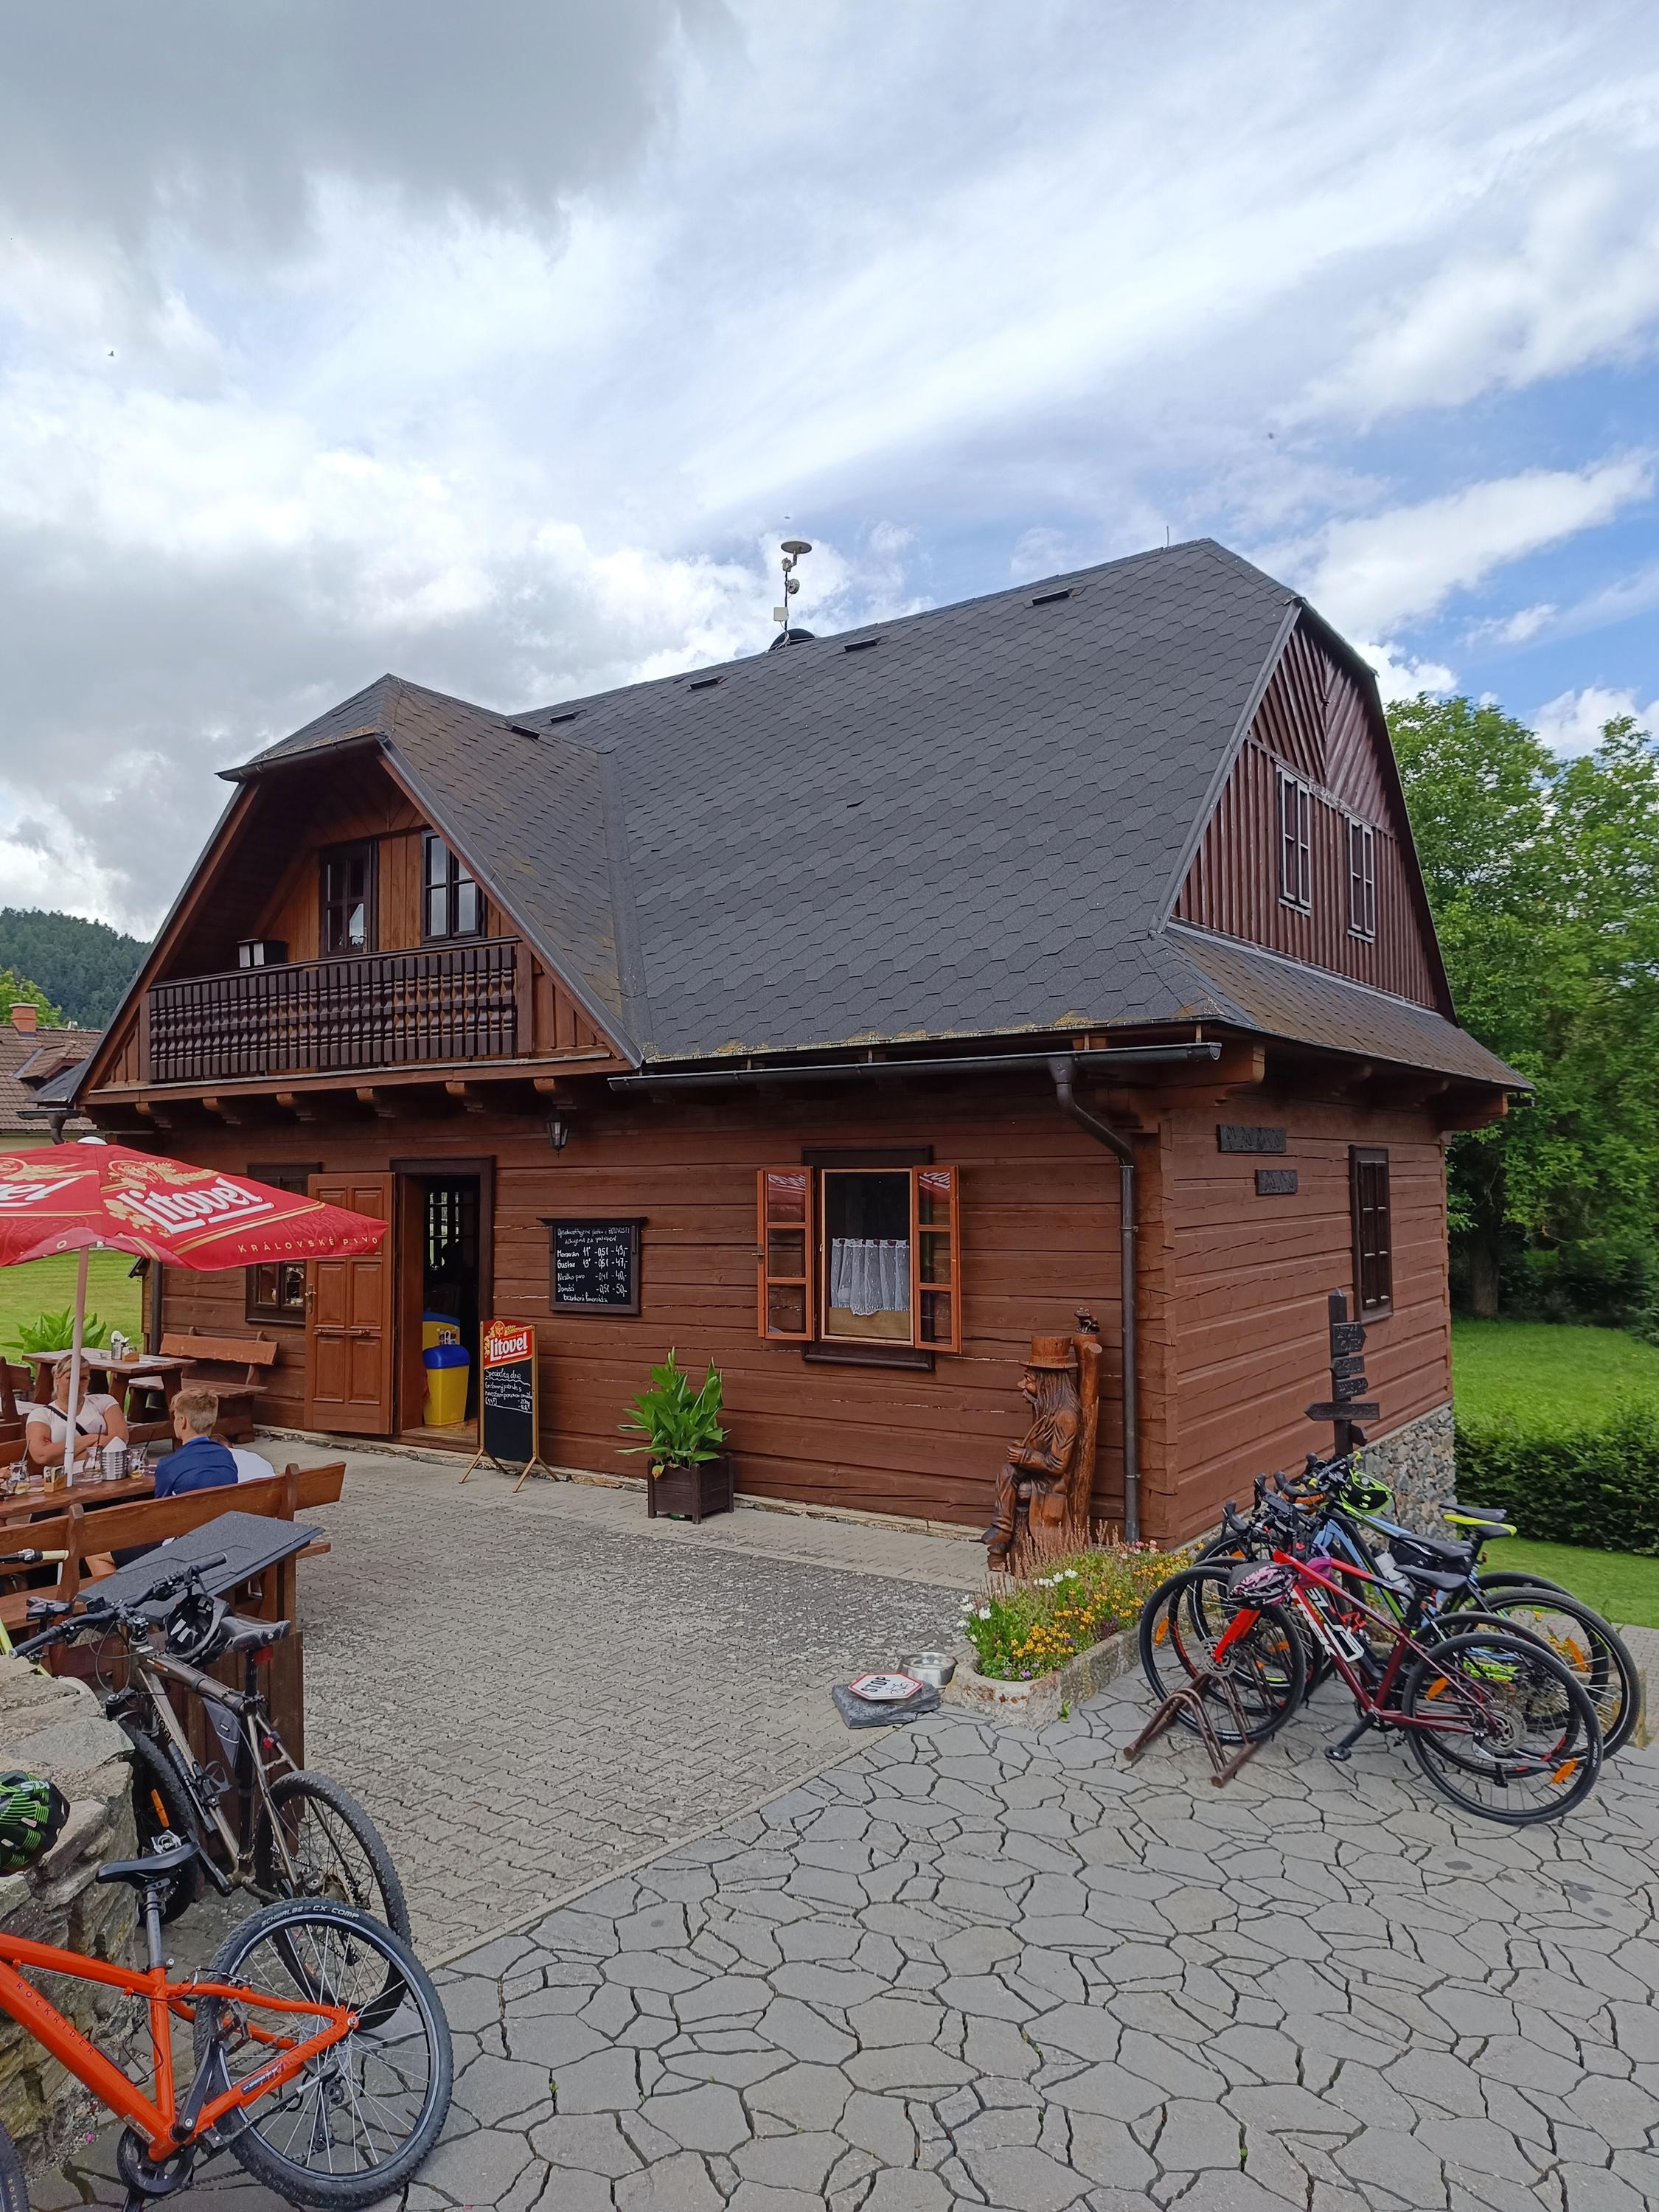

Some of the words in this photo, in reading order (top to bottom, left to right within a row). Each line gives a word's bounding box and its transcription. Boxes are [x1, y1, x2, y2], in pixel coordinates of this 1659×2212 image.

[116, 1177, 264, 1234] Litovel
[238, 1236, 334, 1253] KRÁLOVSKÉ
[343, 1237, 378, 1245] PIVO
[490, 1332, 529, 1362] Litovel
[1290, 1589, 1338, 1657] TREK
[861, 1676, 891, 1693] STOP
[261, 1906, 303, 1928] SCHWALBE
[331, 1907, 360, 1919] COMP
[15, 1981, 95, 2056] ROCKRIDER
